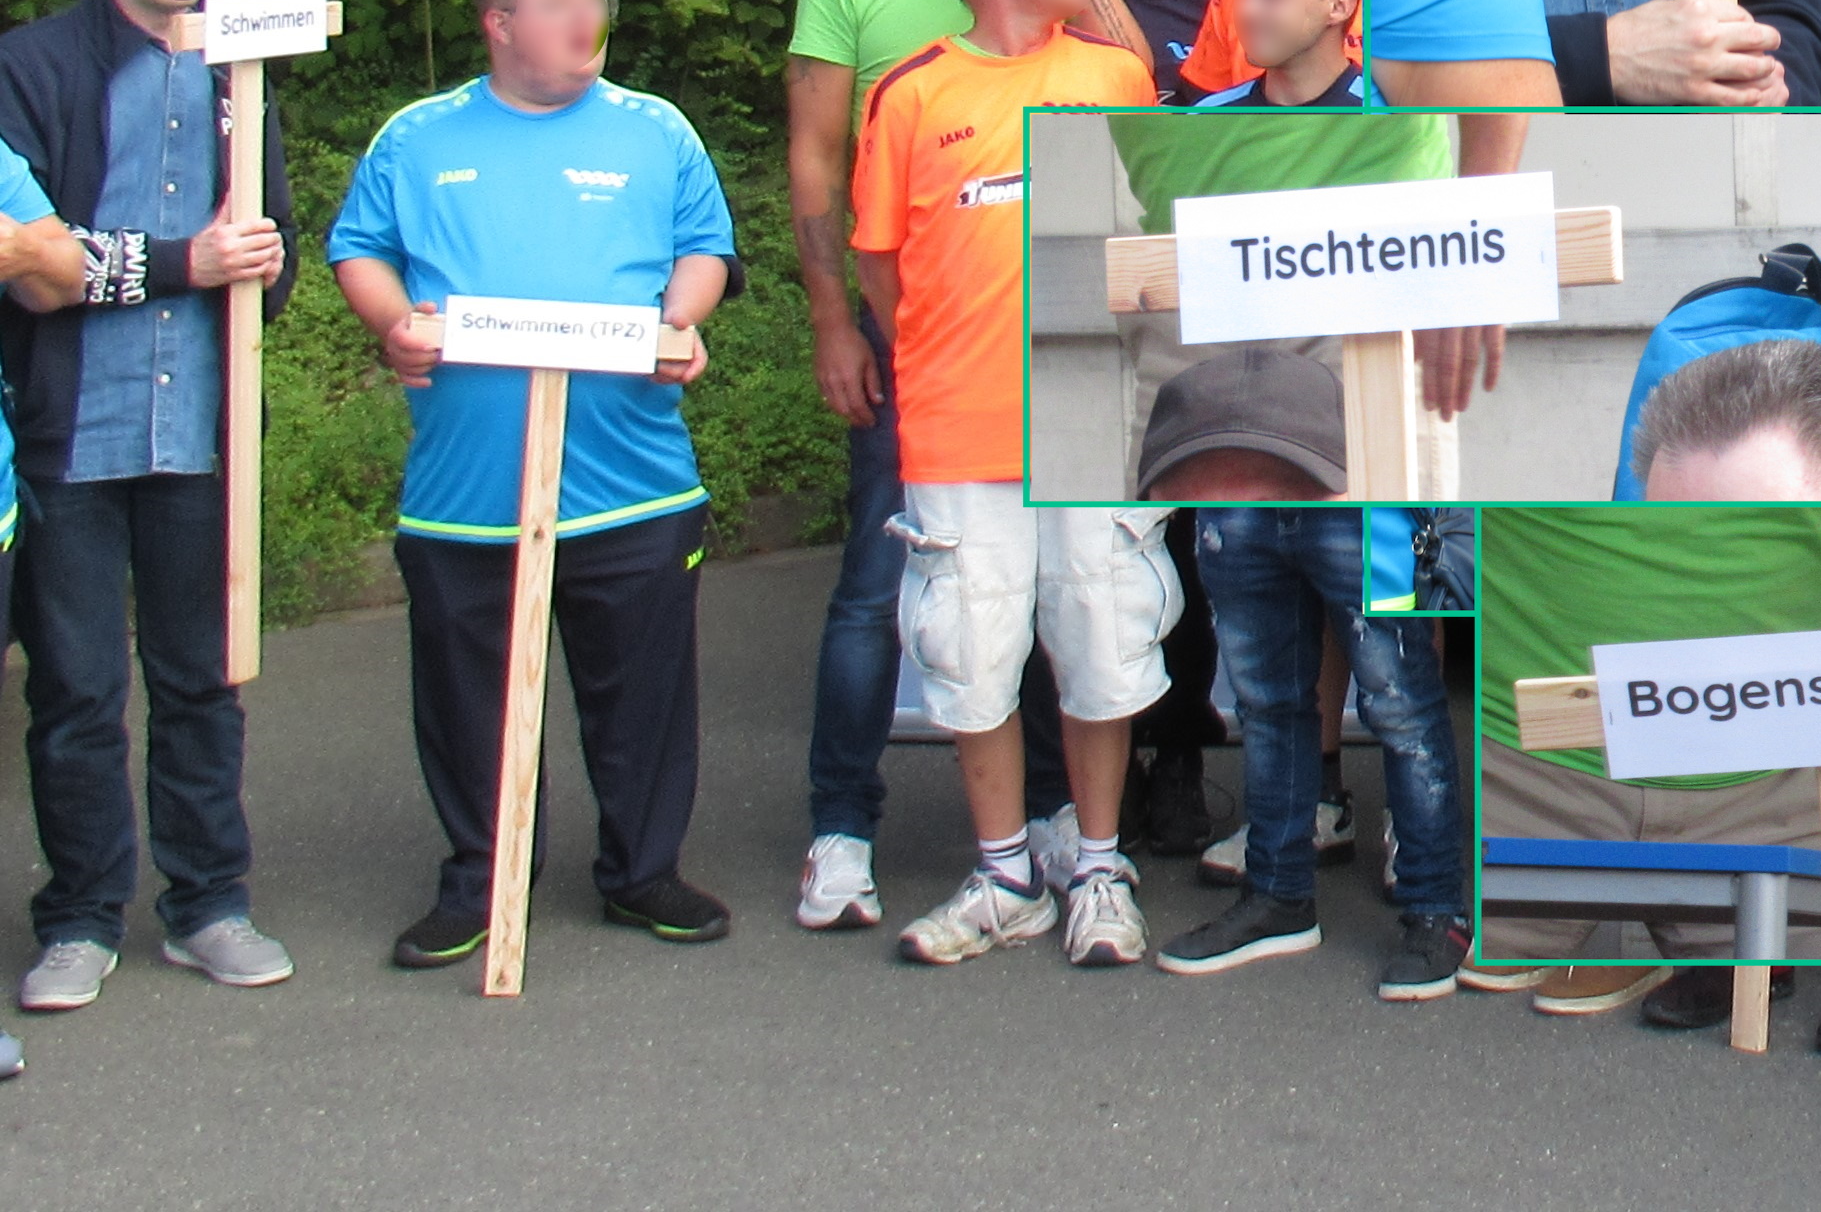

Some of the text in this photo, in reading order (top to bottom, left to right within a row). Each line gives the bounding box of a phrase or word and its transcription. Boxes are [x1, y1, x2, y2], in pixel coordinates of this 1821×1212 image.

[220, 10, 315, 35] Schwimmen
[938, 126, 975, 148] JAKO
[1230, 219, 1505, 282] Tischtennis
[461, 313, 647, 342] Schwimmen (TPZ)
